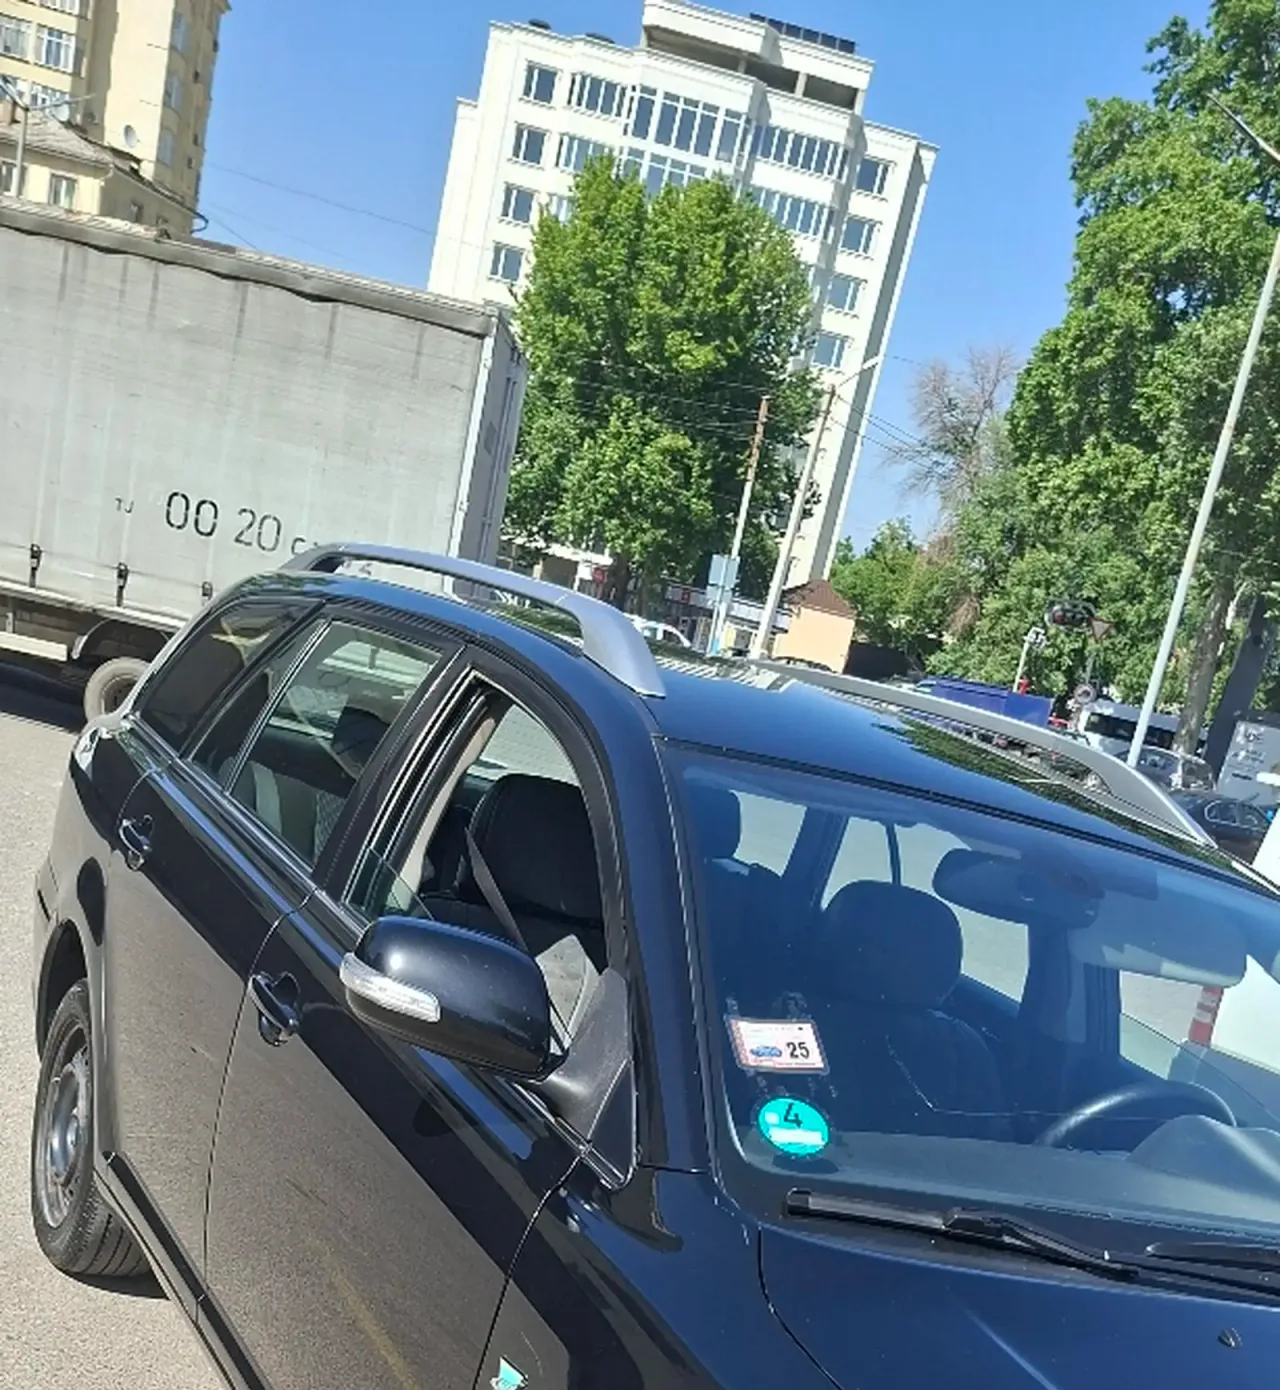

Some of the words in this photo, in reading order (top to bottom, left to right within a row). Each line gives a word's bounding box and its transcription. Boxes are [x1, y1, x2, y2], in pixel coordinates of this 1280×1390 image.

[165, 491, 218, 537] 00
[234, 508, 282, 551] 20
[786, 1041, 810, 1059] 25
[784, 1102, 803, 1128] 4
